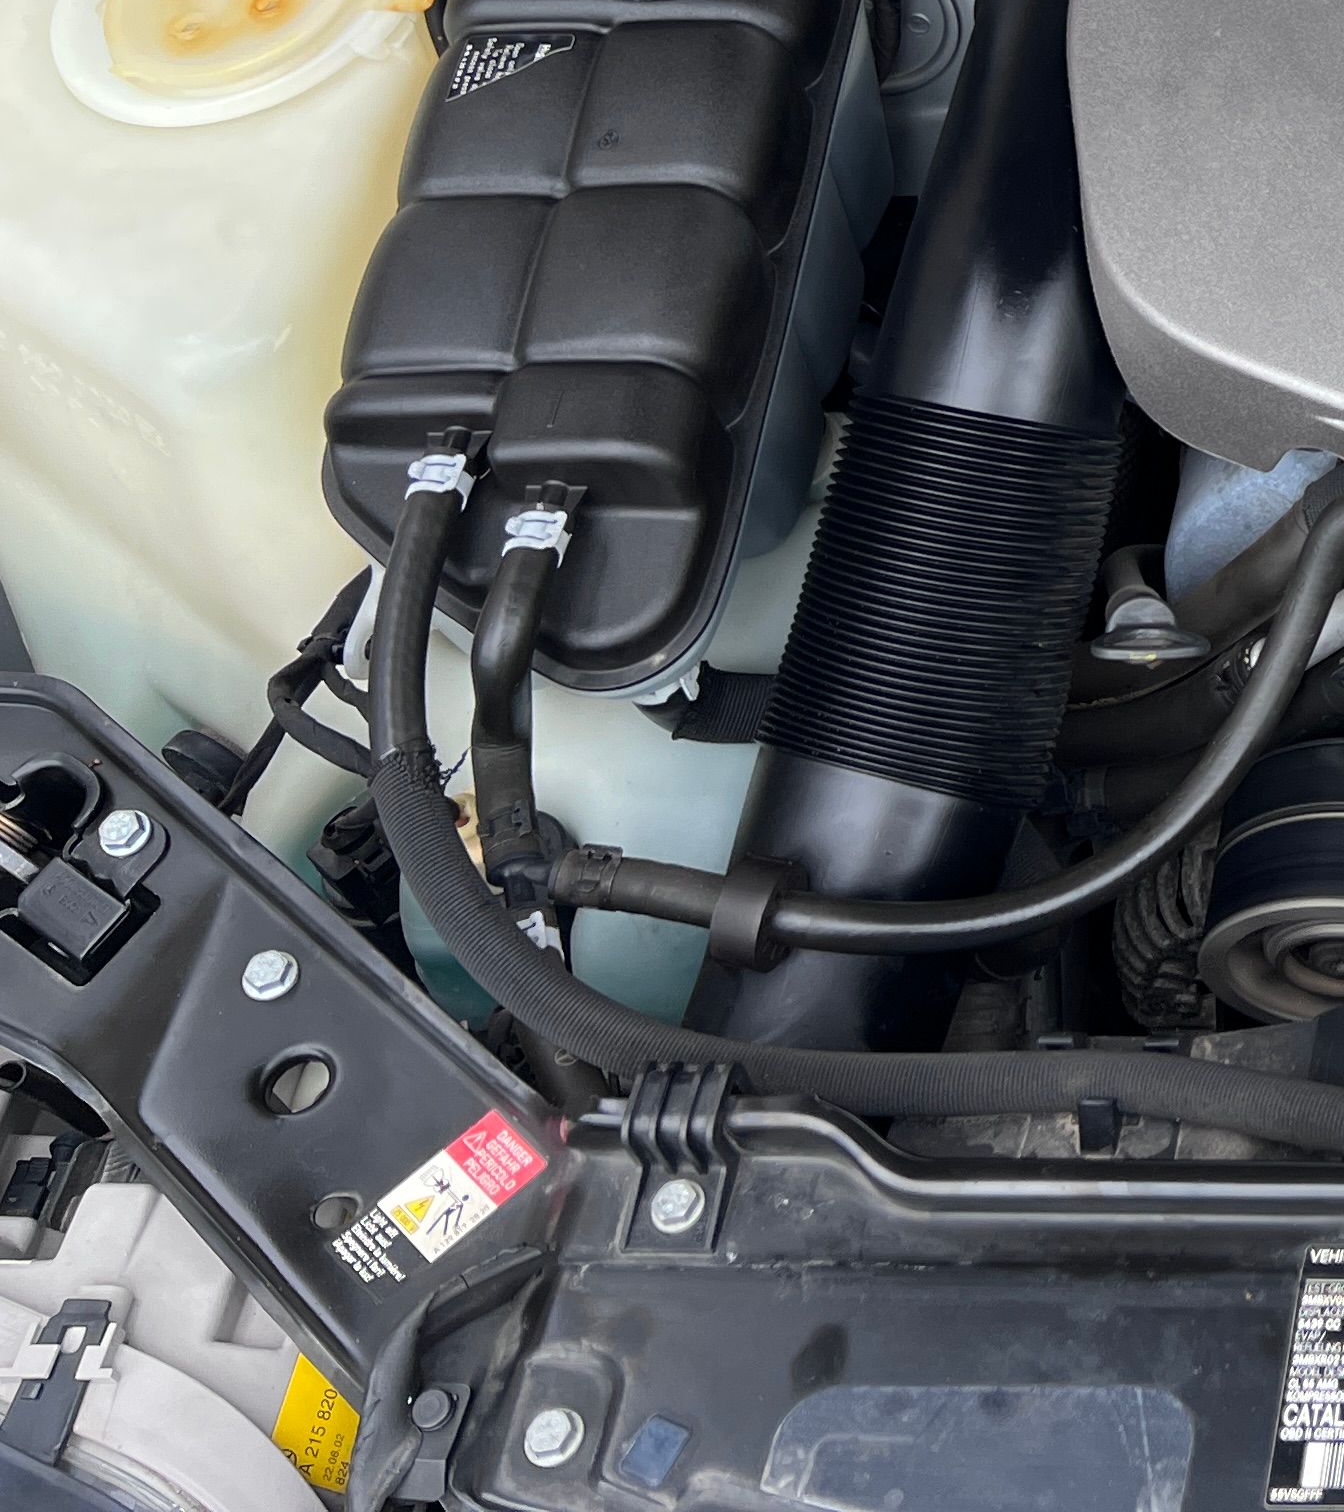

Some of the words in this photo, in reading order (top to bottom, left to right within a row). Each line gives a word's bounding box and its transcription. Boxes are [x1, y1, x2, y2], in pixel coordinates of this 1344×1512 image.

[485, 1140, 520, 1175] GEFAHR
[496, 1130, 533, 1167] DANGER
[463, 1158, 500, 1195] PELIGRO
[477, 1148, 516, 1191] PERICOLO
[360, 1215, 378, 1235] Licht
[370, 1208, 388, 1228] Light
[1316, 1378, 1339, 1390] AMG
[316, 1388, 338, 1421] 820
[304, 1426, 327, 1459] 215
[1279, 1427, 1304, 1441] OBD
[298, 1463, 312, 1477] A
[322, 1433, 344, 1482] 22.08.02
[335, 1460, 350, 1486] 824
